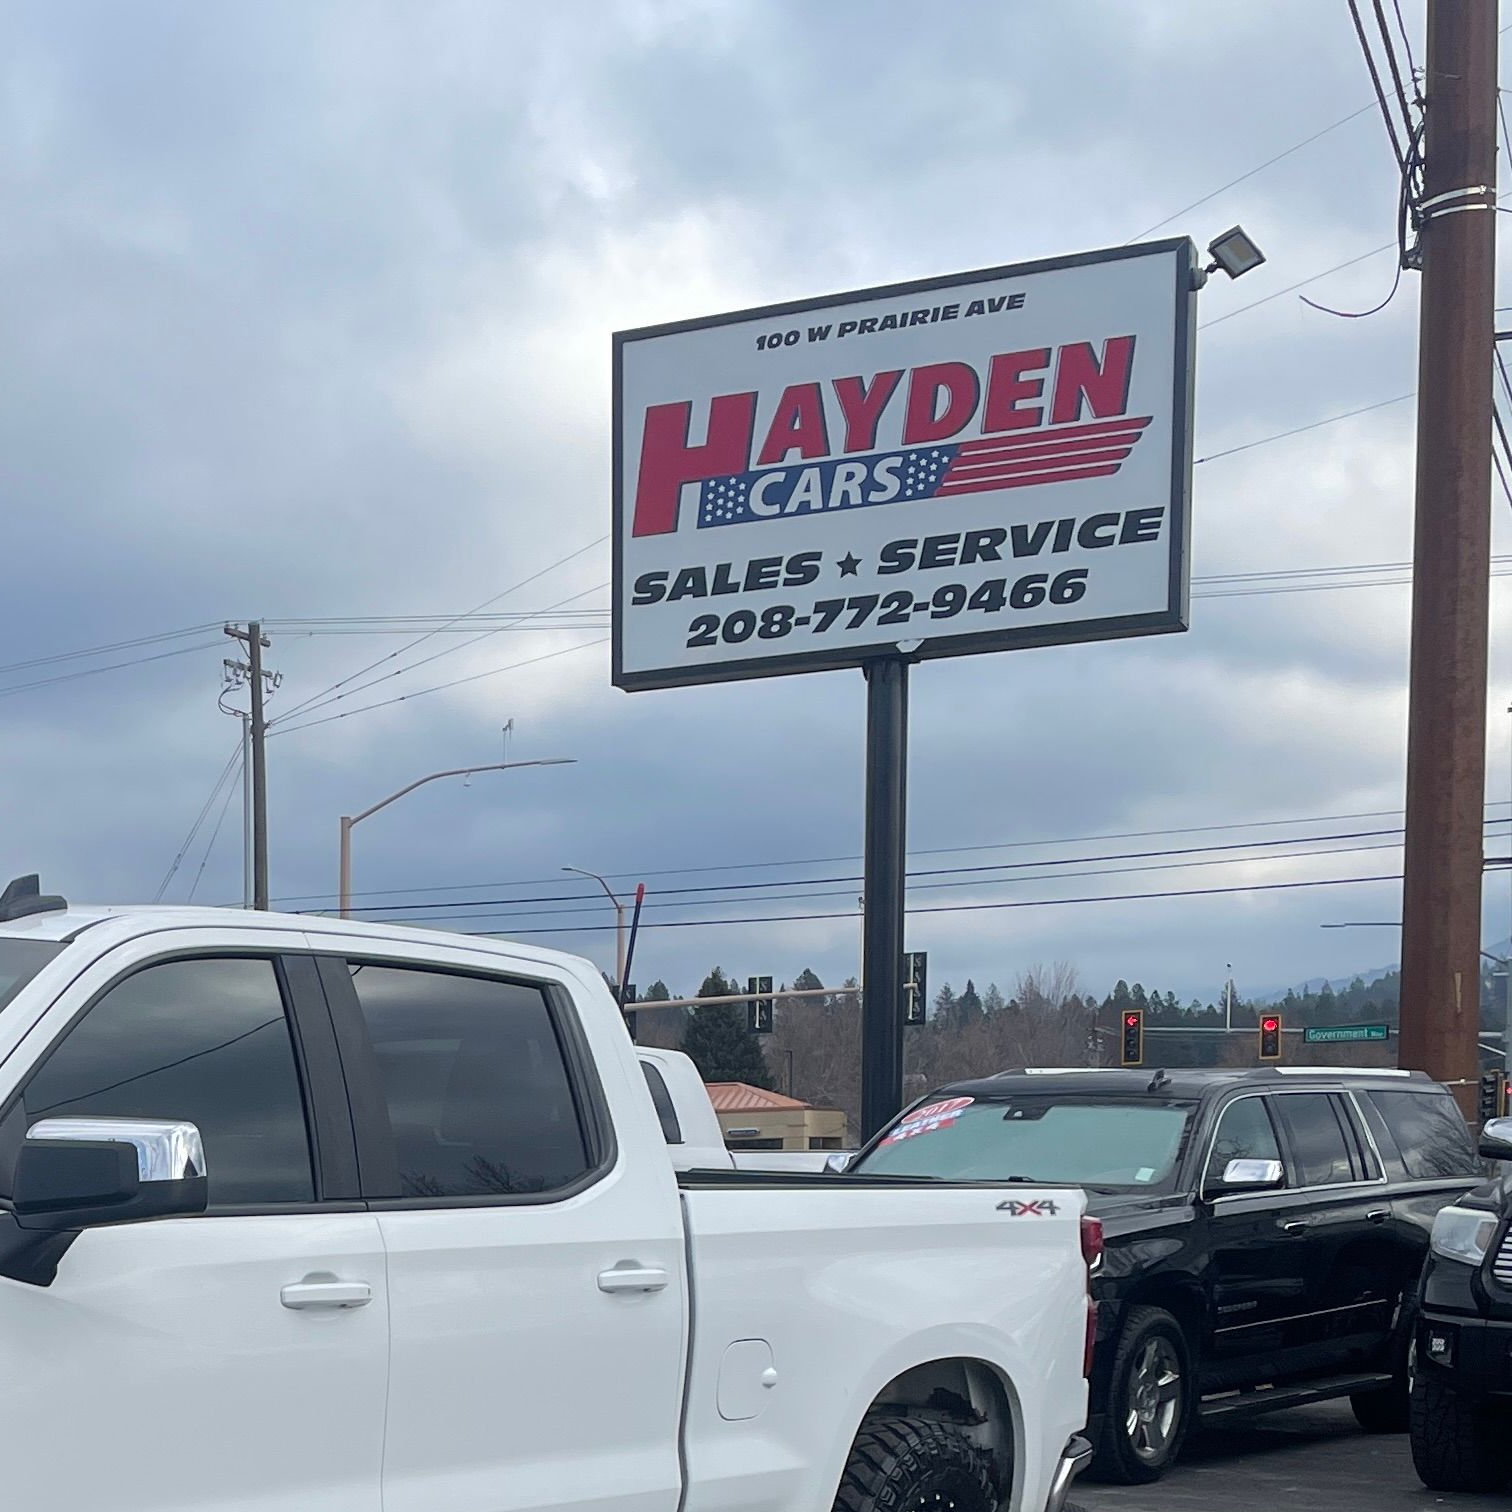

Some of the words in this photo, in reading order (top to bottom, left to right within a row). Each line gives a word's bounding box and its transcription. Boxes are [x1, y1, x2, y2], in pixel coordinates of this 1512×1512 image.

[755, 330, 800, 351] 100
[807, 324, 833, 342] W
[837, 303, 960, 339] PRAIRIE
[964, 292, 1027, 317] AVE
[631, 334, 1138, 539] HAYDEN
[748, 455, 905, 518] CARS
[631, 551, 823, 606] SALES
[878, 506, 1166, 576] SERVICE
[686, 568, 1089, 649] 208-772-9466
[1309, 1027, 1368, 1040] Government
